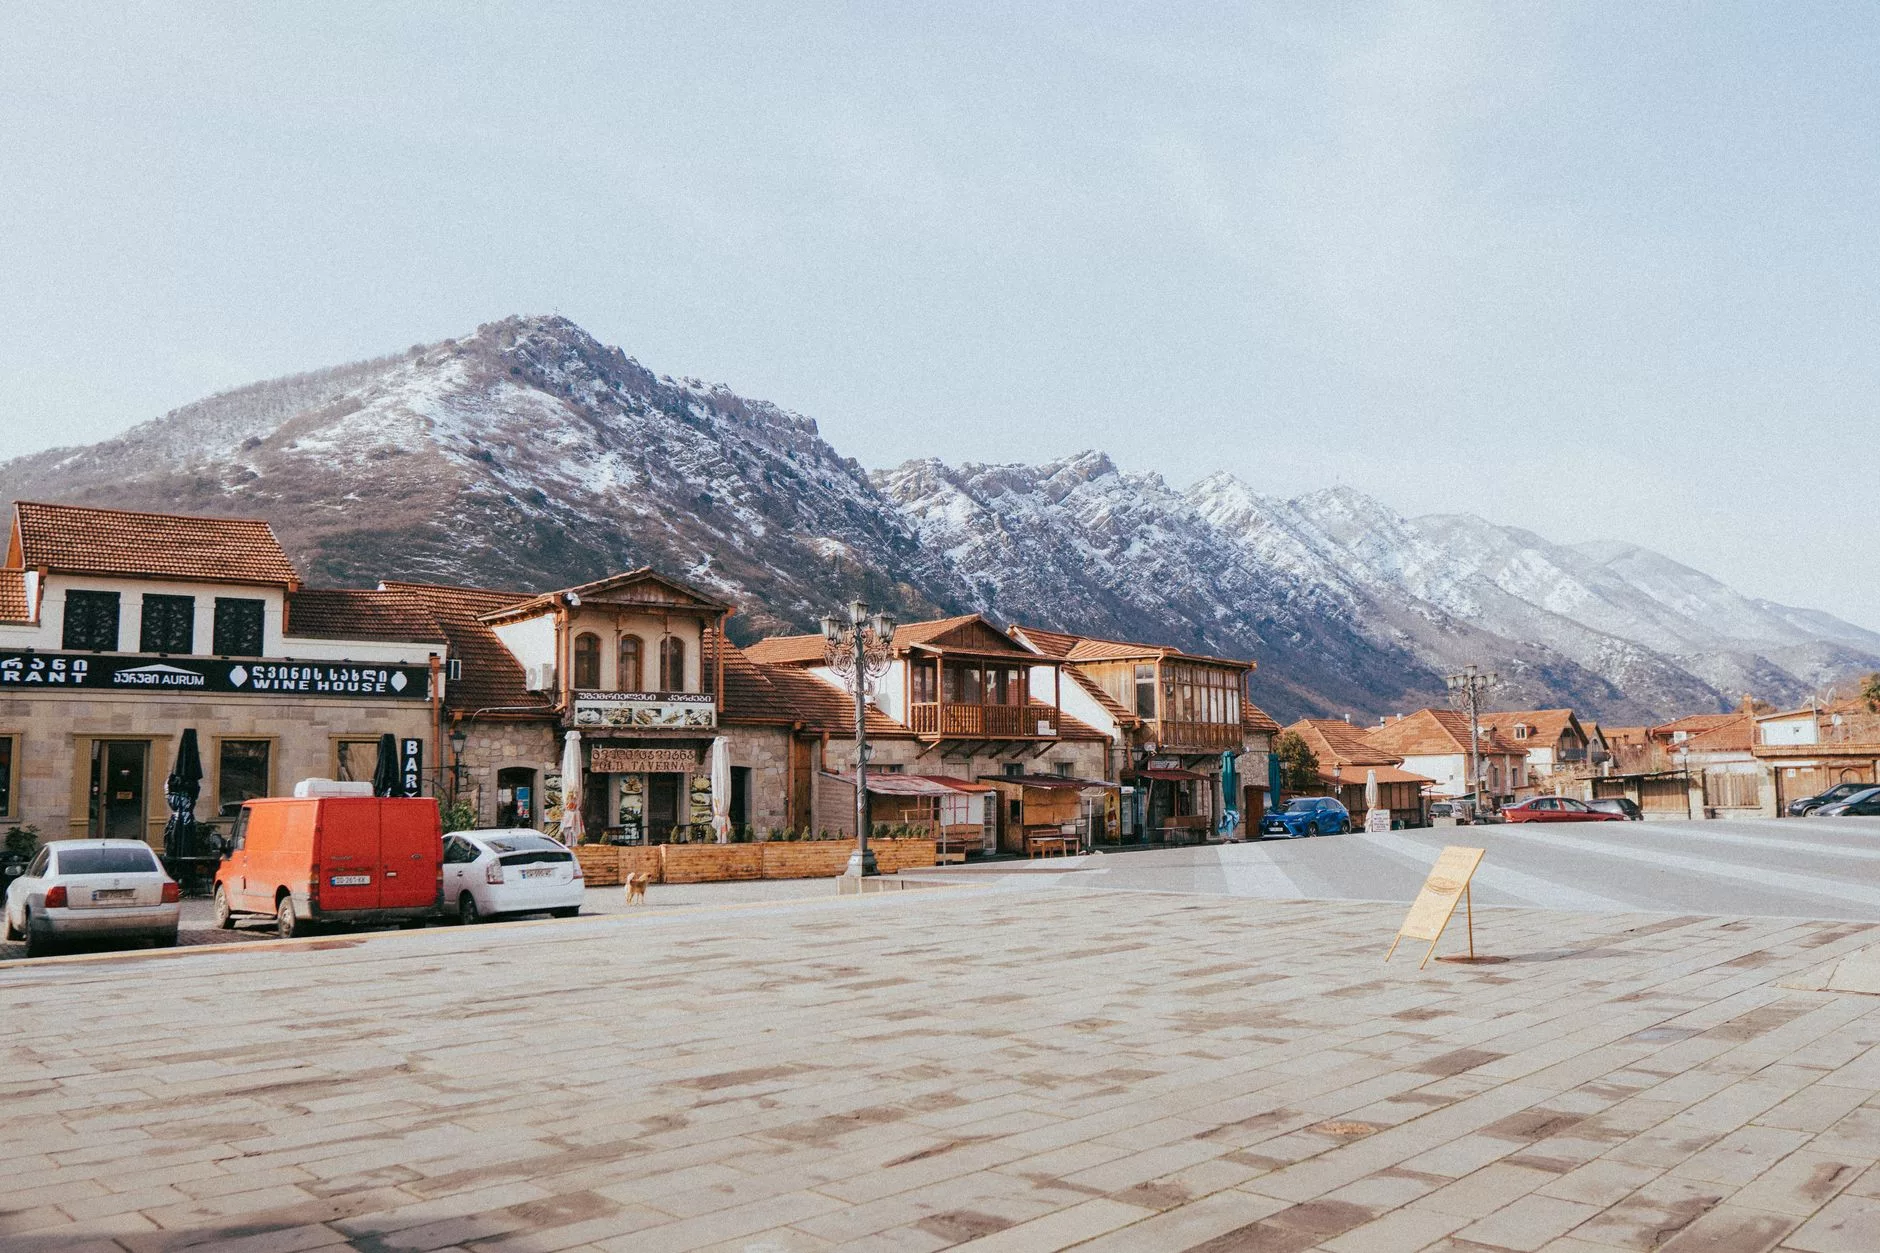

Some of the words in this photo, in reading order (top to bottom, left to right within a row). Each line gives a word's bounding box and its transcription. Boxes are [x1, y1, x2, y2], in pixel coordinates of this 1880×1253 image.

[3, 671, 88, 683] RANT
[252, 666, 322, 680] ღვინის
[329, 668, 388, 682] სახლი
[161, 675, 205, 686] AURUM
[253, 679, 310, 690] WINE
[317, 681, 386, 692] HOUSE
[405, 740, 418, 788] BAR
[600, 761, 624, 770] OLD
[632, 761, 686, 770] TAVERNA
